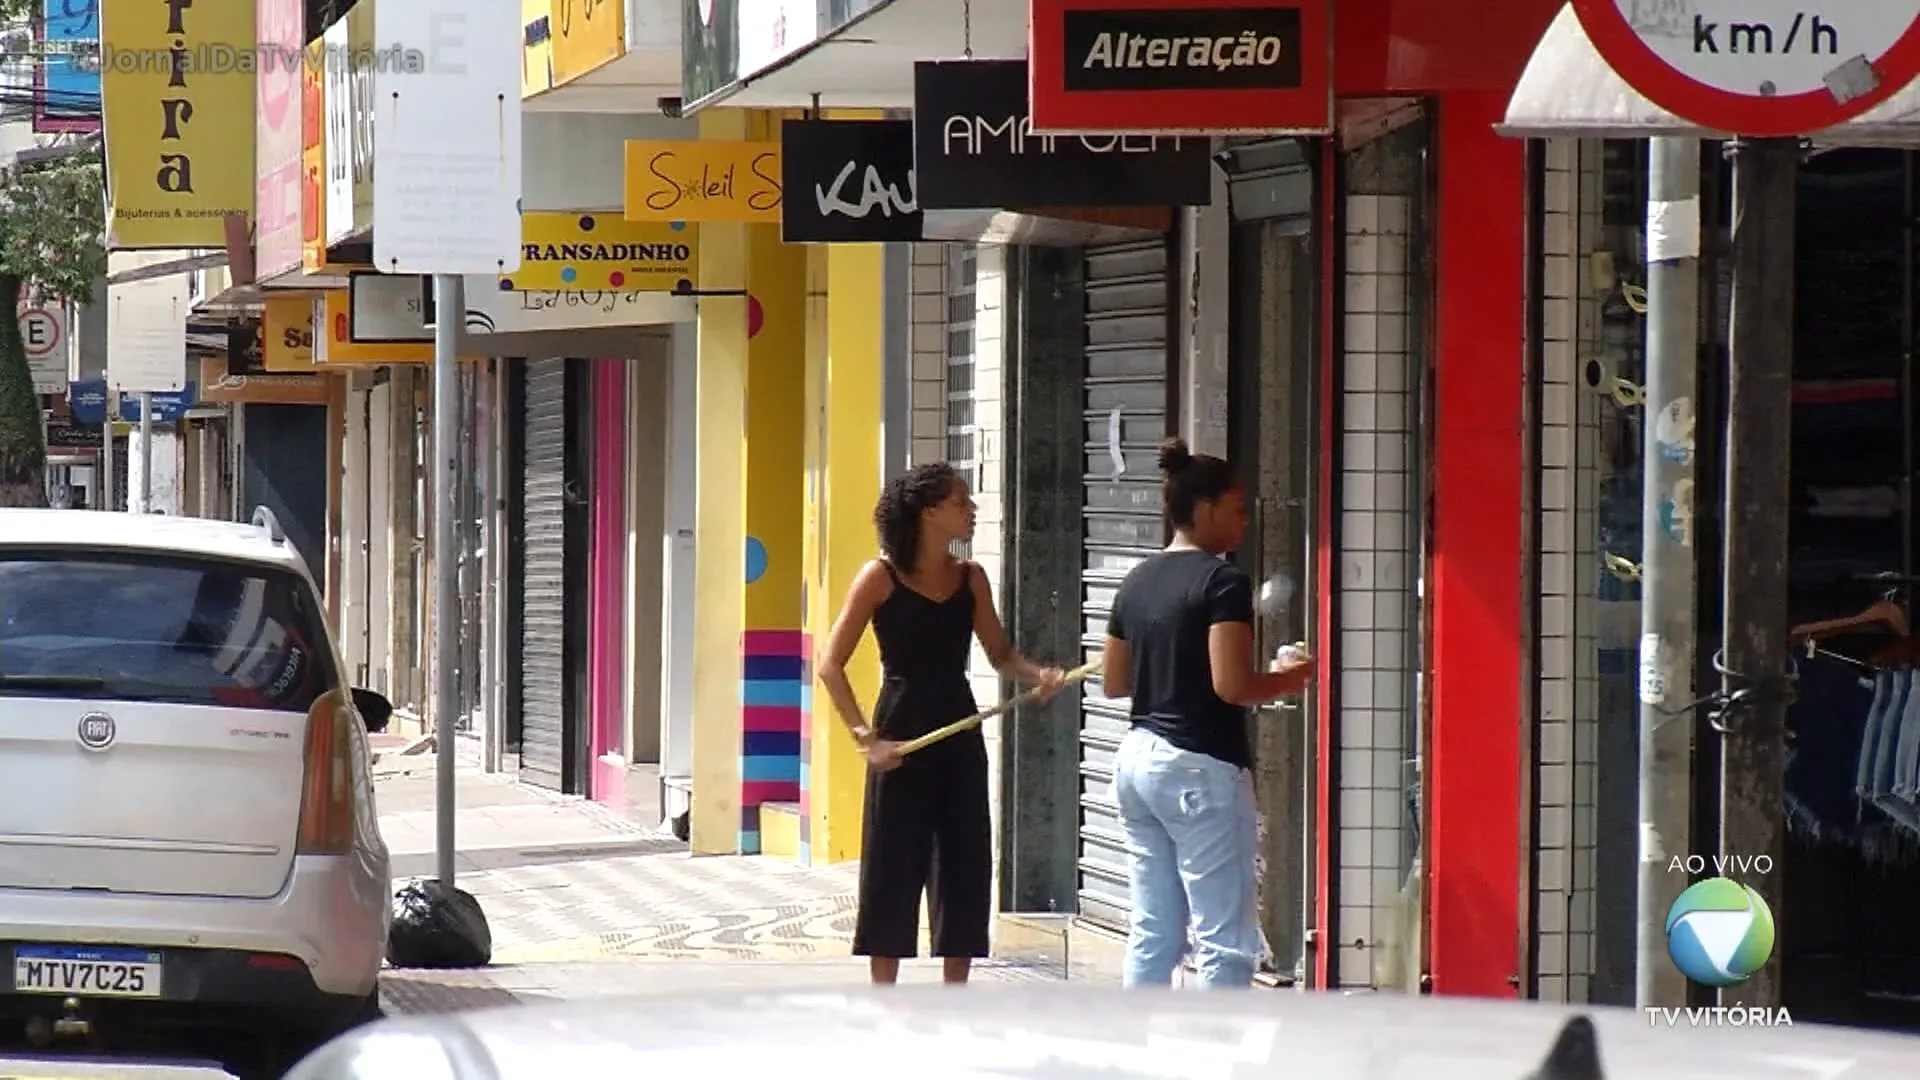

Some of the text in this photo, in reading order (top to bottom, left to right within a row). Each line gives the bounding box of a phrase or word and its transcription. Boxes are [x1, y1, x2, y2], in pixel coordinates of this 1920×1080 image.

[1693, 13, 1839, 55] km/h
[1083, 31, 1281, 72] Alteração
[115, 208, 171, 220] Bijuterias
[174, 207, 182, 218] &
[522, 244, 690, 261] RANSADINHO
[28, 319, 45, 344] E
[27, 961, 145, 992] MTV7C25
